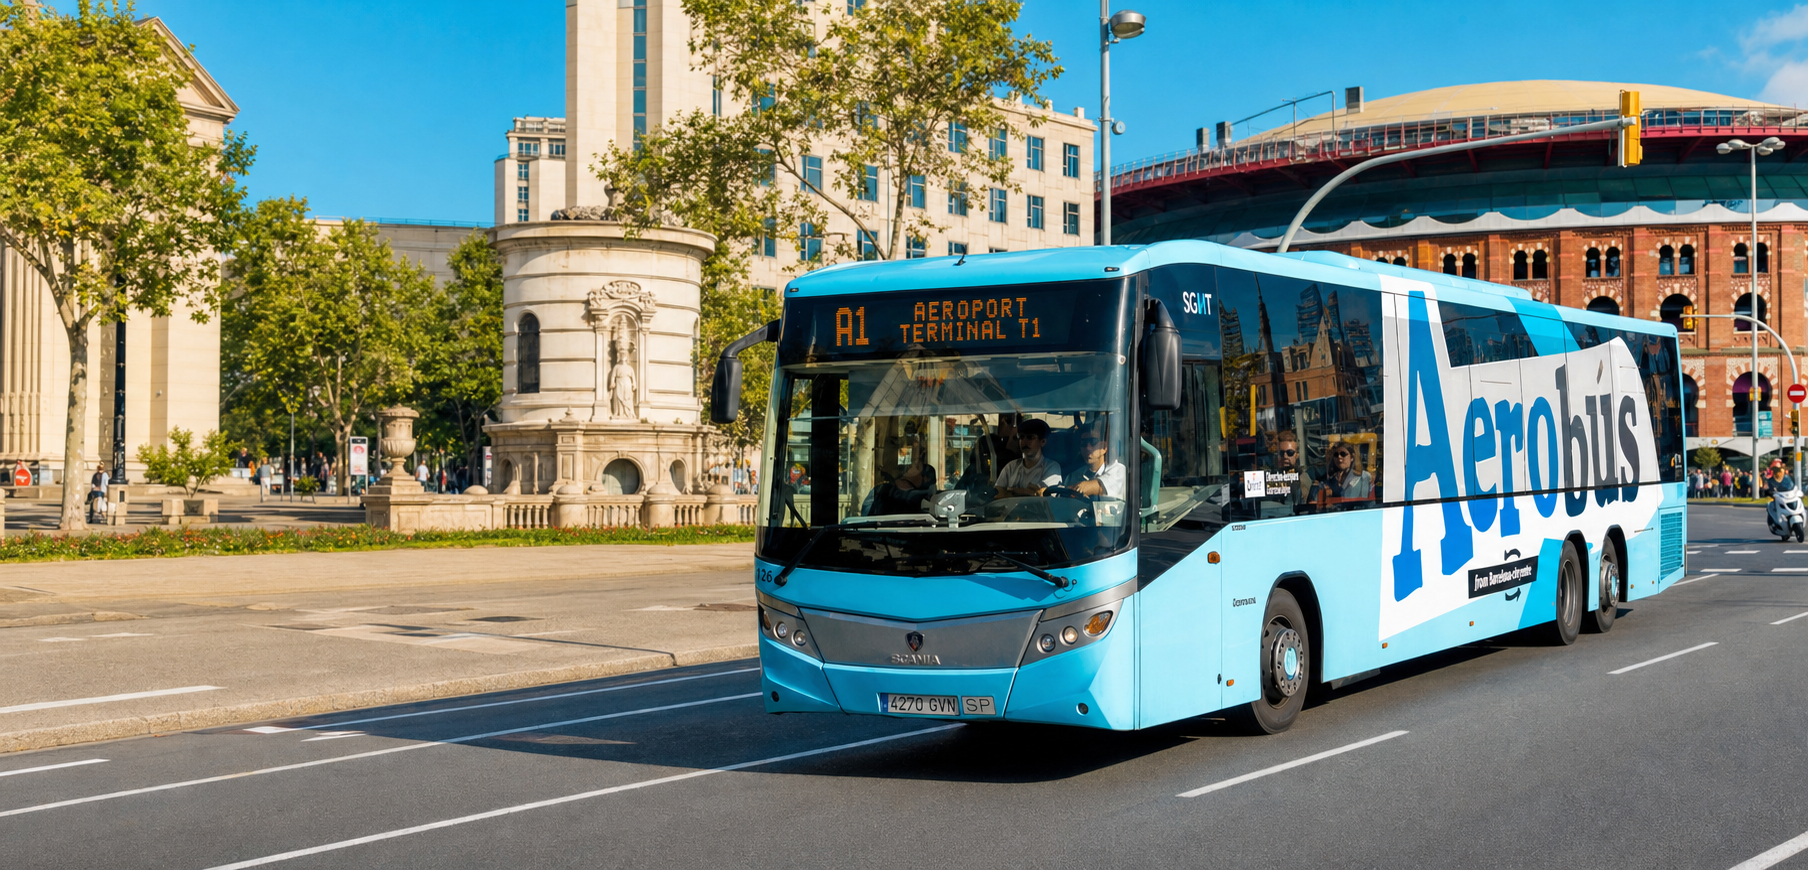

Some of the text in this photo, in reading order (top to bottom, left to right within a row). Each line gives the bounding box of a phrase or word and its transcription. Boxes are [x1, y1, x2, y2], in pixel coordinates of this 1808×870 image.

[914, 297, 1027, 322] AEROPORT
[836, 306, 869, 346] A1
[900, 317, 1040, 344] TERMINAL T1
[1392, 290, 1640, 602] Aerobús
[891, 653, 941, 665] SCANIA
[890, 696, 956, 713] 4270 GVN
[966, 698, 990, 713] SP
